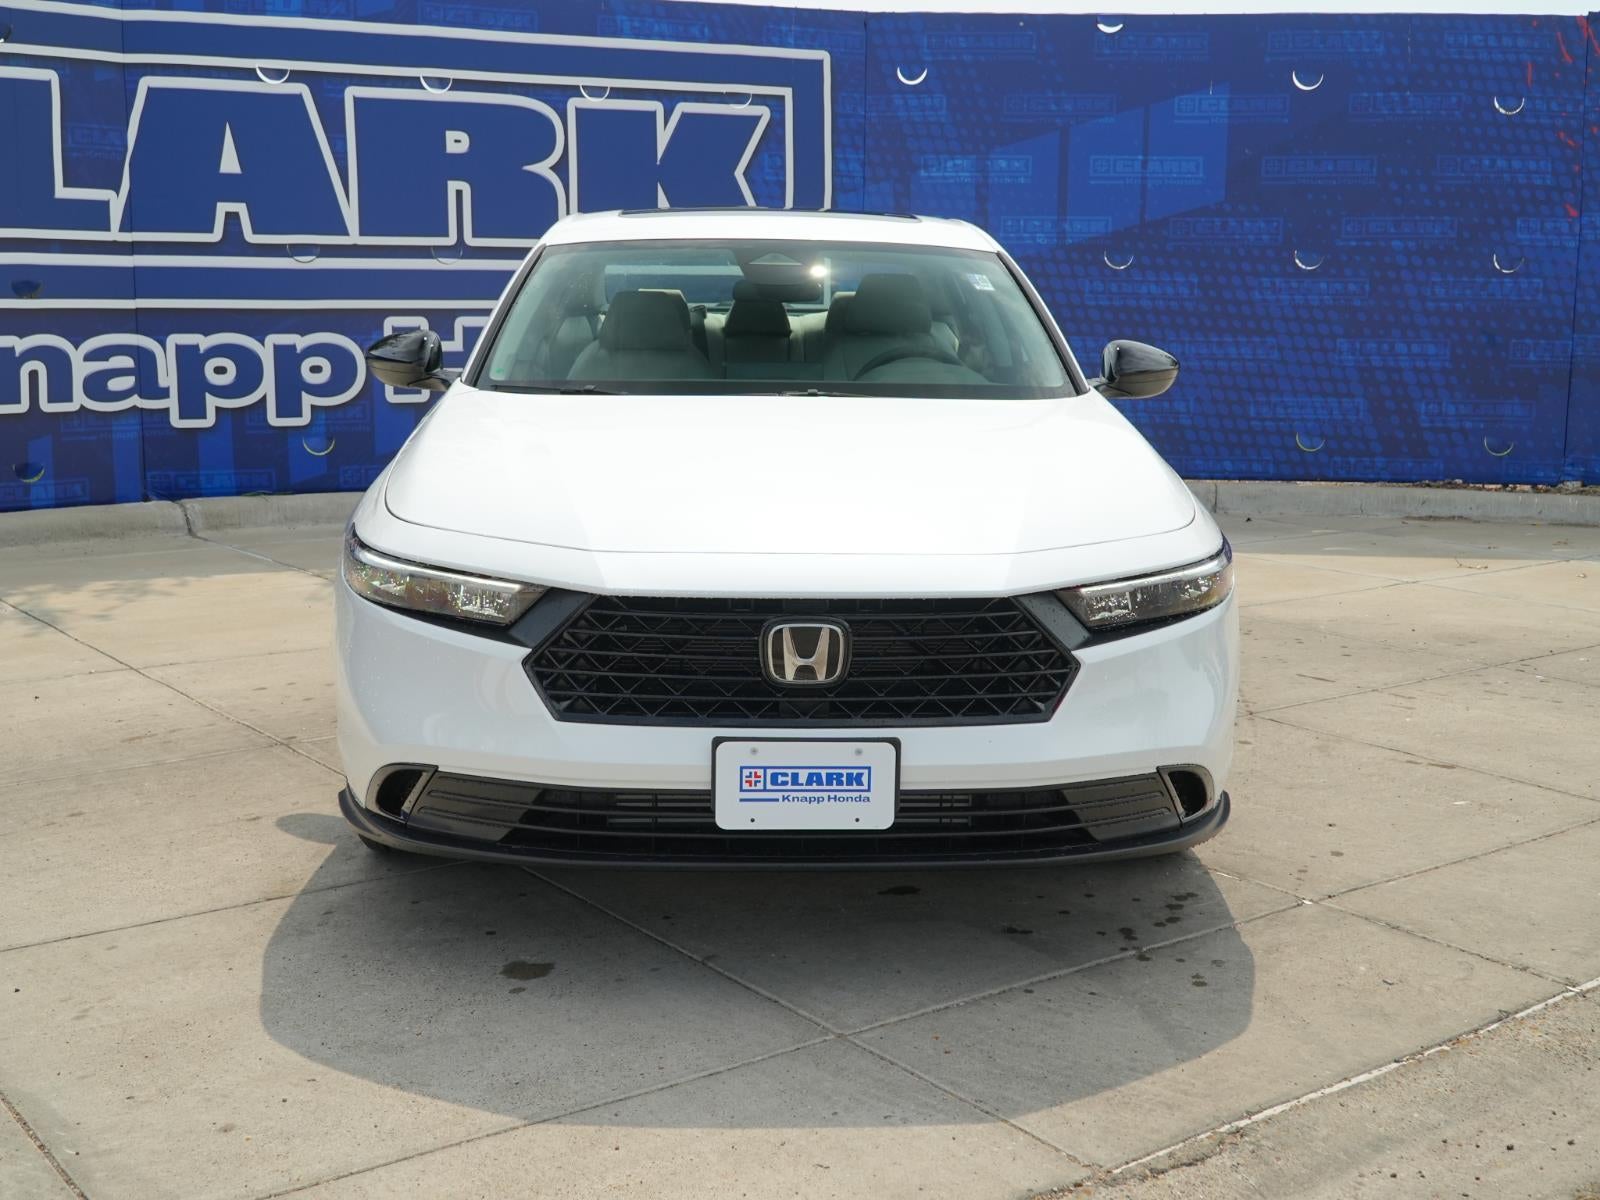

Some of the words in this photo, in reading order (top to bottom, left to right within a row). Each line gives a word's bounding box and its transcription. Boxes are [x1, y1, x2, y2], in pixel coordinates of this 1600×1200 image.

[0, 332, 368, 430] napp
[770, 771, 865, 787] CLARK
[781, 794, 825, 804] Knapp
[827, 794, 871, 803] Honda
